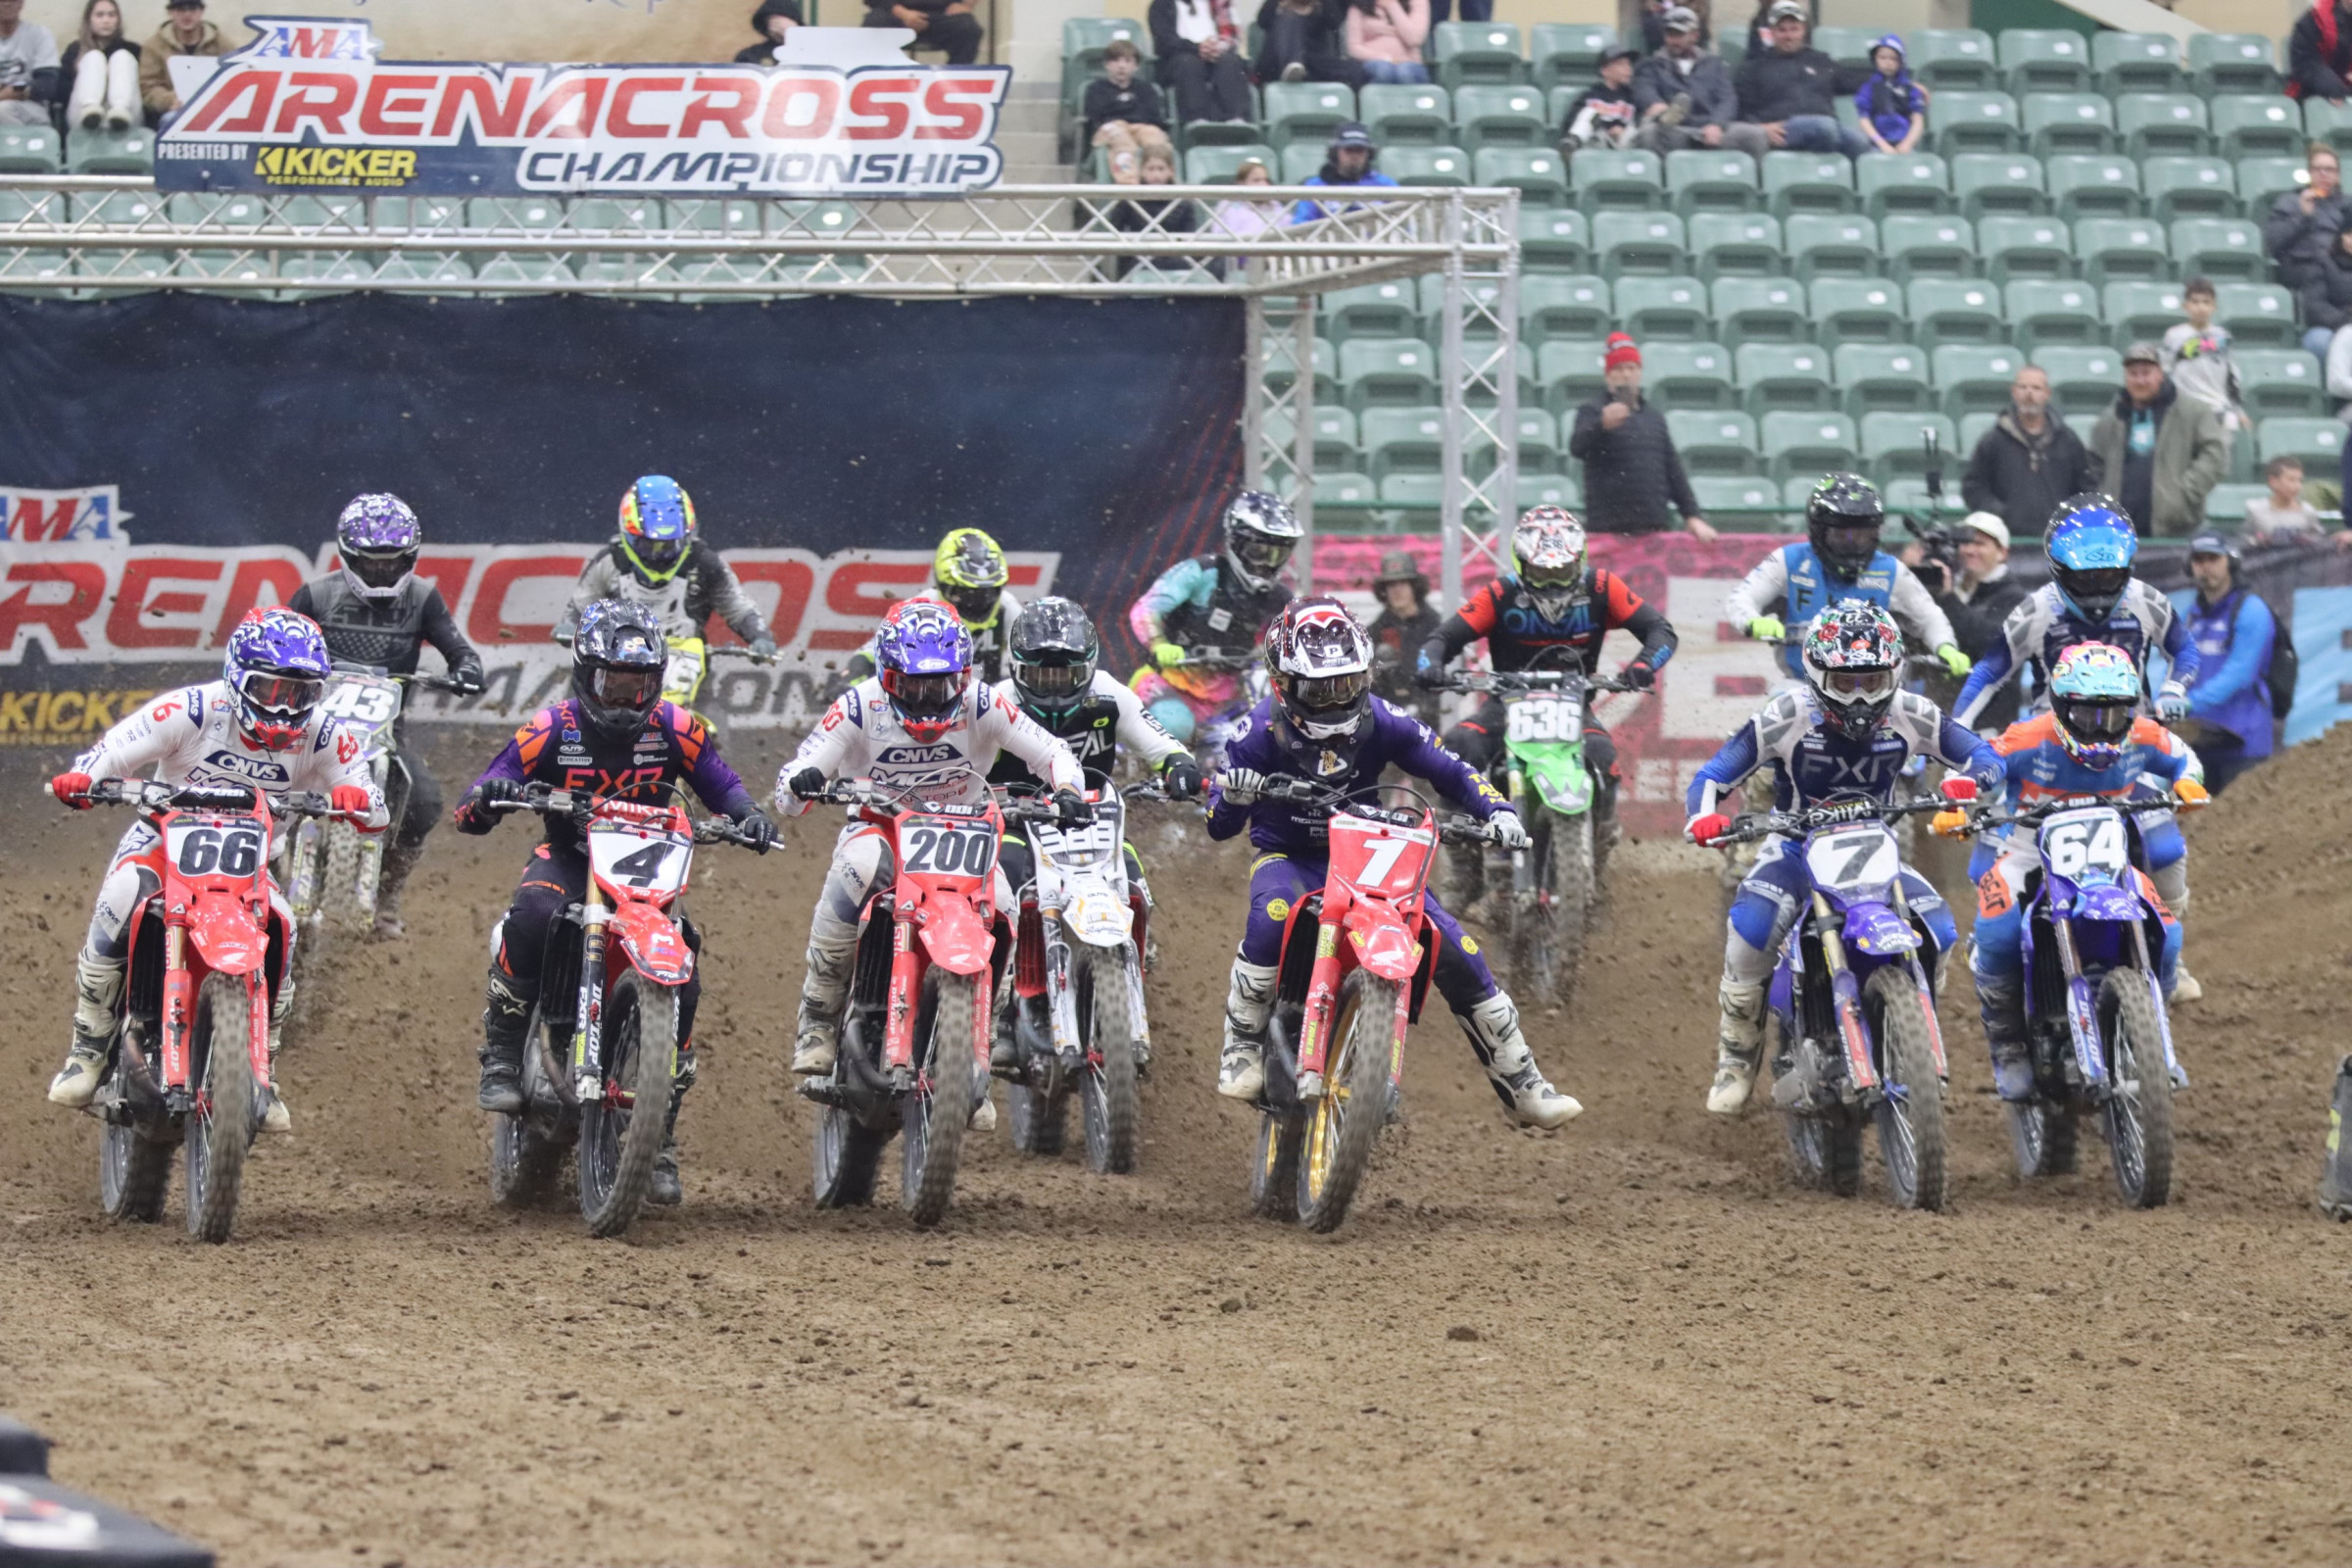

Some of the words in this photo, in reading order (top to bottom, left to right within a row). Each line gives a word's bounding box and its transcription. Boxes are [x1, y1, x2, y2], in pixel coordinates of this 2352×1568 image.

[254, 26, 364, 60] AMA
[181, 71, 996, 140] ARENACROSS
[158, 143, 229, 160] PRESENTED
[231, 144, 248, 162] BY
[284, 148, 417, 177] KICKER
[525, 151, 990, 184] CHAMPIONSHIP
[267, 175, 360, 186] PERFORMANCE
[364, 177, 405, 187] AUDIO
[0, 494, 113, 543] MA
[321, 683, 394, 722] 43
[1509, 699, 1582, 743] 636
[218, 754, 280, 782] CNVS
[888, 746, 949, 763] CNVS
[1800, 752, 1902, 783] FXR
[564, 766, 664, 798] FXR
[868, 760, 973, 787] MCR
[179, 828, 259, 876] 66
[610, 841, 677, 888] 4
[904, 828, 994, 876] 200
[1354, 838, 1409, 888] 1
[1832, 834, 1886, 884] 7
[2050, 820, 2127, 878] 64
